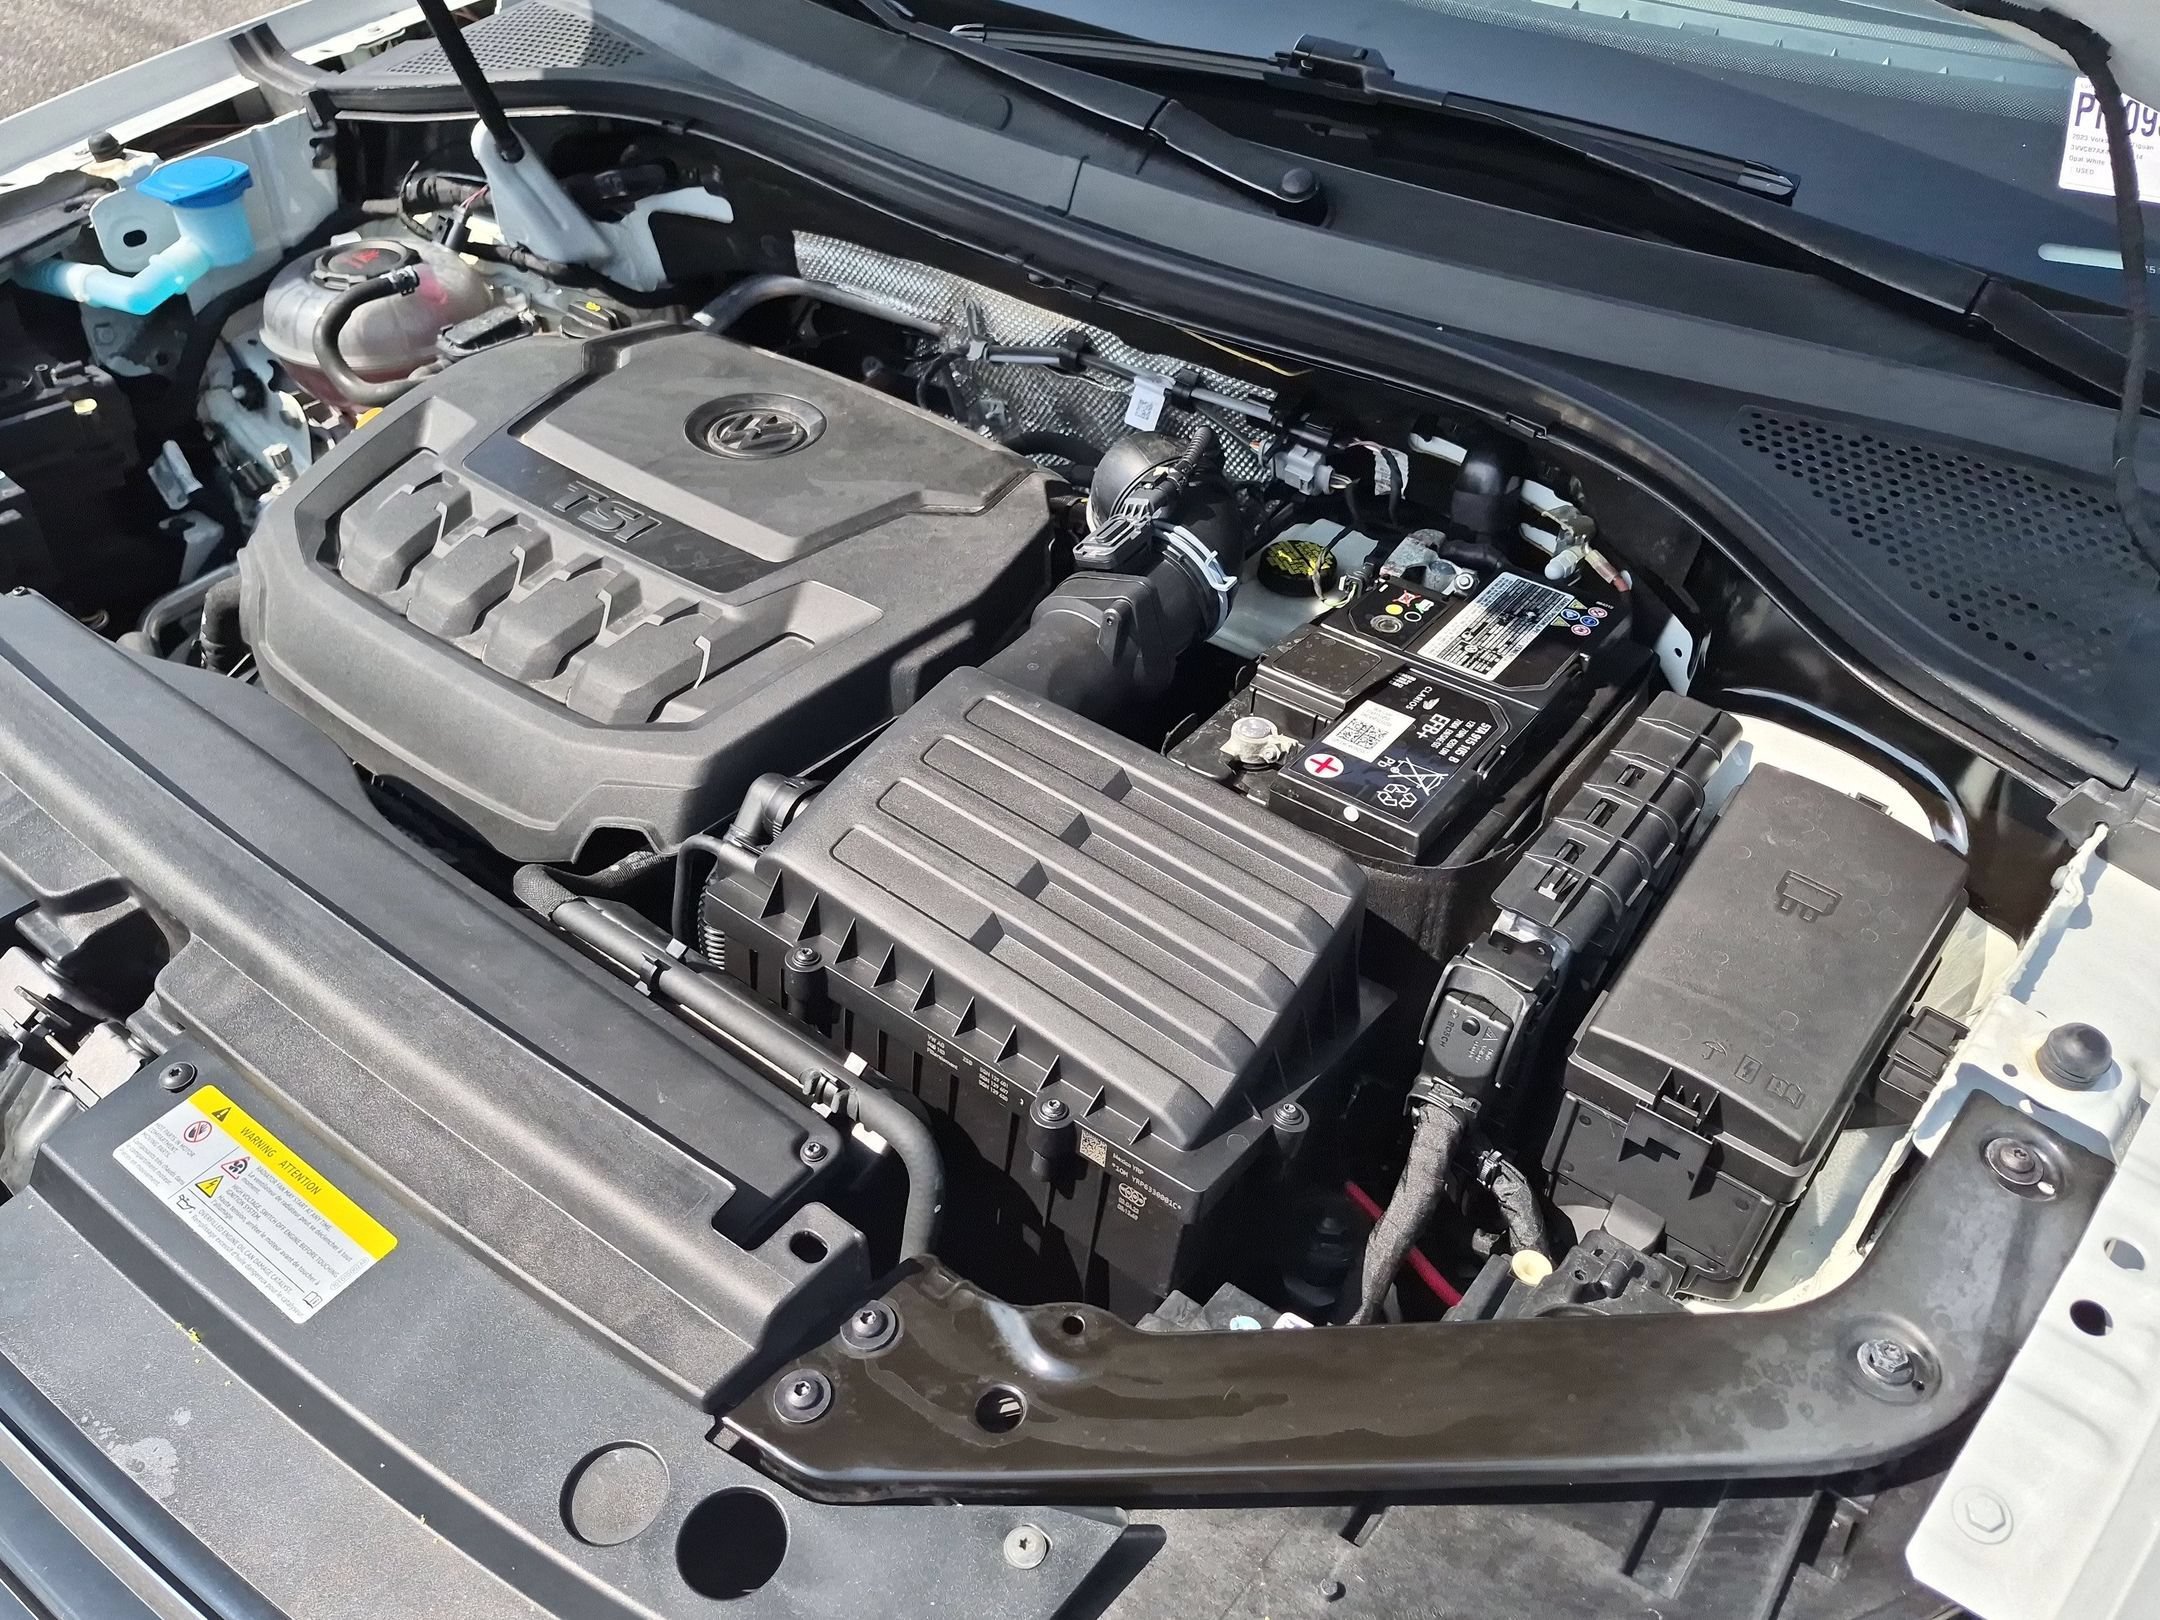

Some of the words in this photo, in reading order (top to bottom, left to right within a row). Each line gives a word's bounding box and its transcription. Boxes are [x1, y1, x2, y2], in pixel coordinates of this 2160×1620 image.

[552, 480, 662, 543] TSI
[1406, 686, 1432, 710] CLARIOS
[1416, 713, 1451, 738] EFB+
[1464, 732, 1482, 746] 915
[1474, 722, 1492, 734] 5TA
[1377, 756, 1396, 768] Pb
[1454, 744, 1470, 757] 105
[1440, 1020, 1455, 1048] BOSCH
[178, 1142, 196, 1157] MOTOR
[240, 1127, 276, 1157] WARNING
[279, 1160, 321, 1194] ATTENTION
[224, 1188, 246, 1206] IGNITION
[255, 1165, 278, 1184] RADIATOR
[275, 1182, 287, 1192] FAN
[283, 1189, 295, 1199] MAY
[292, 1196, 308, 1210] START
[310, 1211, 322, 1222] ANY
[230, 1183, 245, 1195] HIGH
[259, 1207, 278, 1224] SWITCH
[274, 1221, 286, 1231] OFF
[282, 1228, 301, 1244] ENGINE
[298, 1242, 318, 1259] BEFORE
[314, 1256, 340, 1278] TOUCHING
[252, 1176, 277, 1197] ventilateur
[279, 1199, 302, 1218] radiateur
[297, 1215, 312, 1227] peut
[313, 1228, 340, 1250] déclencher
[340, 1251, 354, 1262] tout
[197, 1208, 225, 1232] OVERFILLED
[220, 1229, 240, 1246] ENGINE
[236, 1243, 246, 1252] OIL
[242, 1249, 255, 1260] CAN
[251, 1257, 273, 1276] DAMAGE
[216, 1194, 232, 1207] Haute
[263, 1236, 282, 1252] moteur
[278, 1249, 295, 1263] avant
[297, 1265, 317, 1283] toucher
[189, 1214, 218, 1239] Remplissage
[214, 1236, 233, 1253] excessif
[242, 1262, 269, 1285] dangereux
[264, 1282, 278, 1294] pour
